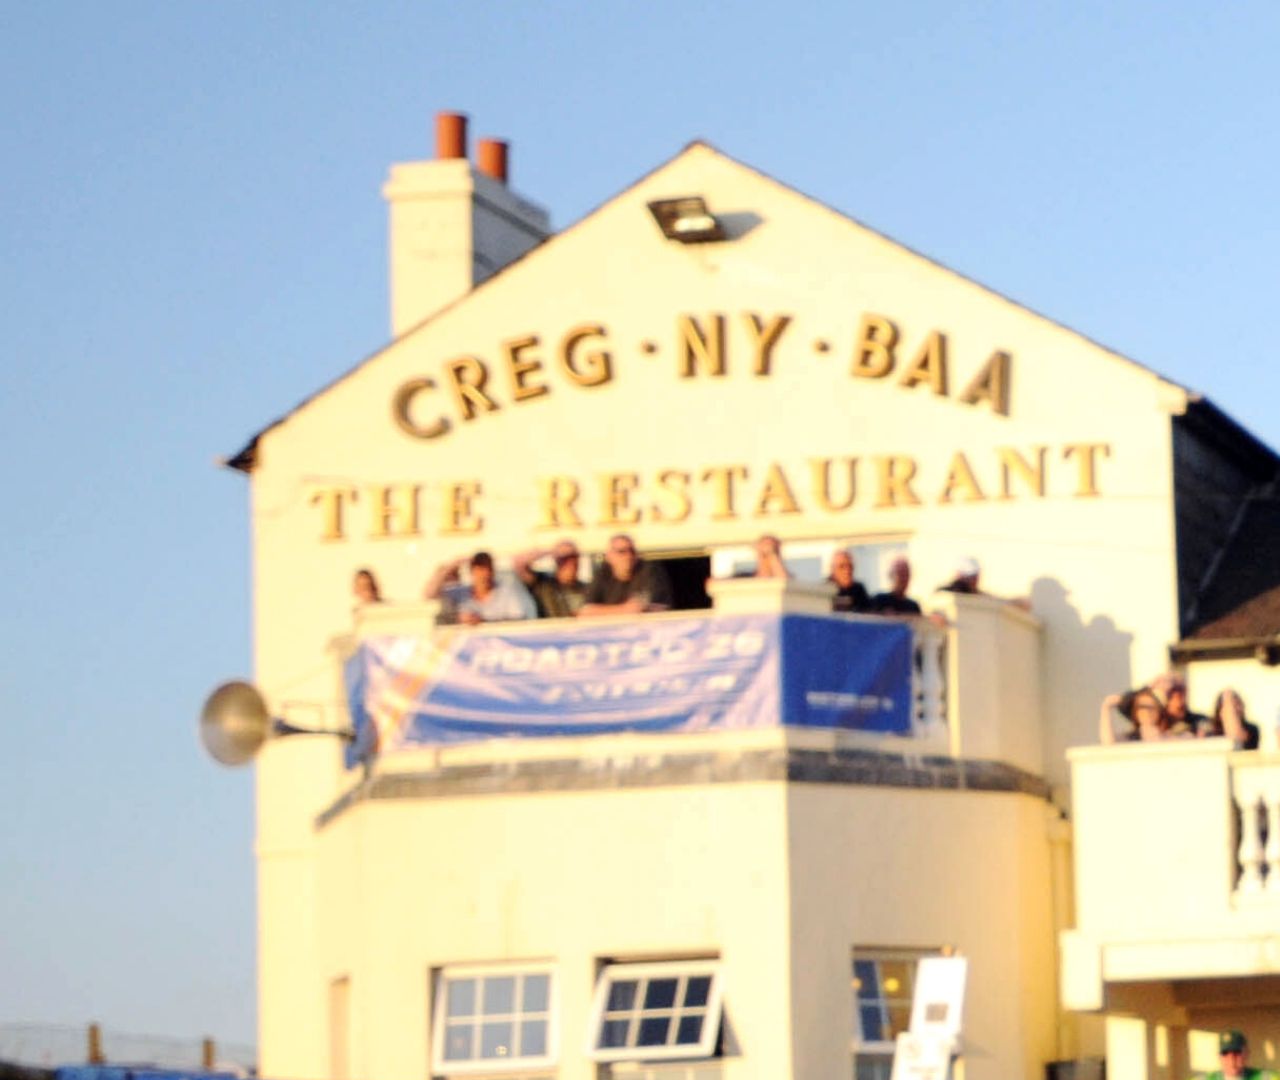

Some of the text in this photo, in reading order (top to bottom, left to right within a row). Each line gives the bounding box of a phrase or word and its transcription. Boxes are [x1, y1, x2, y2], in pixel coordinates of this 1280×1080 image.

[391, 312, 1013, 440] CREG NY BAA
[310, 442, 1111, 543] THE RESTAURANT
